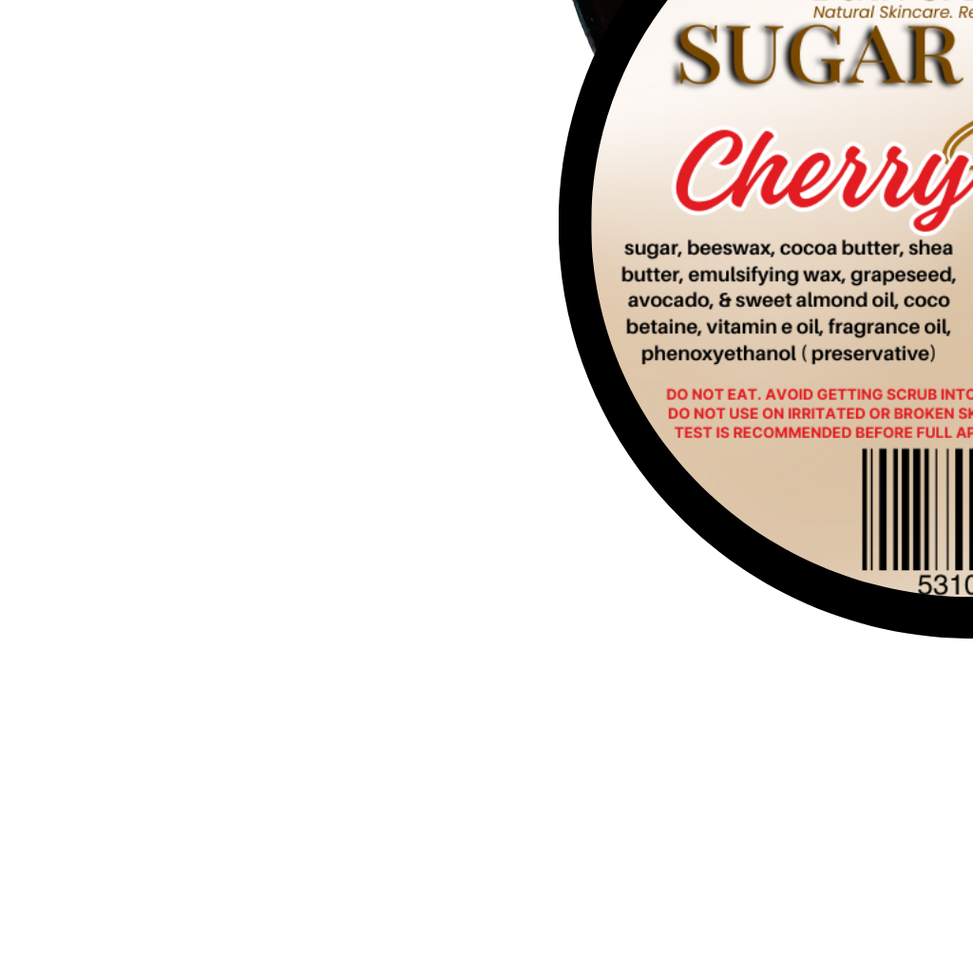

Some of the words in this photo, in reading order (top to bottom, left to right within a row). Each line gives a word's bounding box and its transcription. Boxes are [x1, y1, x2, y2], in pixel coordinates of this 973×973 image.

[814, 6, 874, 18] Natural
[880, 6, 951, 18] Skincare.
[674, 23, 964, 87] SUGAR
[624, 243, 683, 260] sugar,
[687, 239, 776, 258] beeswax,
[779, 243, 838, 256] cocoa
[841, 239, 904, 258] butter,
[908, 238, 954, 256] shea
[621, 265, 684, 285] butter,
[688, 265, 799, 287] emulsifying
[802, 269, 846, 285] wax,
[850, 265, 957, 287] grapeseed,
[627, 291, 714, 310] avocado,
[718, 292, 732, 308] &
[735, 292, 793, 308] sweet
[795, 291, 868, 308] almond
[871, 291, 899, 310] oil,
[903, 295, 951, 308] coco
[626, 317, 702, 337] betaine,
[706, 318, 777, 335] vitamin
[780, 321, 793, 335] e
[796, 317, 824, 337] oil,
[827, 317, 921, 339] fragrance
[923, 317, 951, 337] oil,
[641, 344, 797, 365] phenoxyethanol
[666, 388, 689, 401] DO
[692, 388, 724, 401] NOT
[727, 388, 762, 401] EAT.
[765, 388, 814, 401] AVOID
[817, 388, 883, 401] GETTING
[886, 388, 938, 401] SCRUB
[668, 407, 690, 420] DO
[693, 407, 726, 420] NOT
[729, 407, 759, 420] USE
[762, 407, 784, 420] ON
[788, 407, 866, 420] IRRITATED
[869, 407, 891, 420] OR
[894, 407, 955, 420] BROKEN
[674, 426, 713, 439] TEST
[716, 426, 730, 439] IS
[733, 426, 852, 439] RECOMMENDED
[855, 426, 913, 439] BEFORE
[916, 426, 953, 439] FULL
